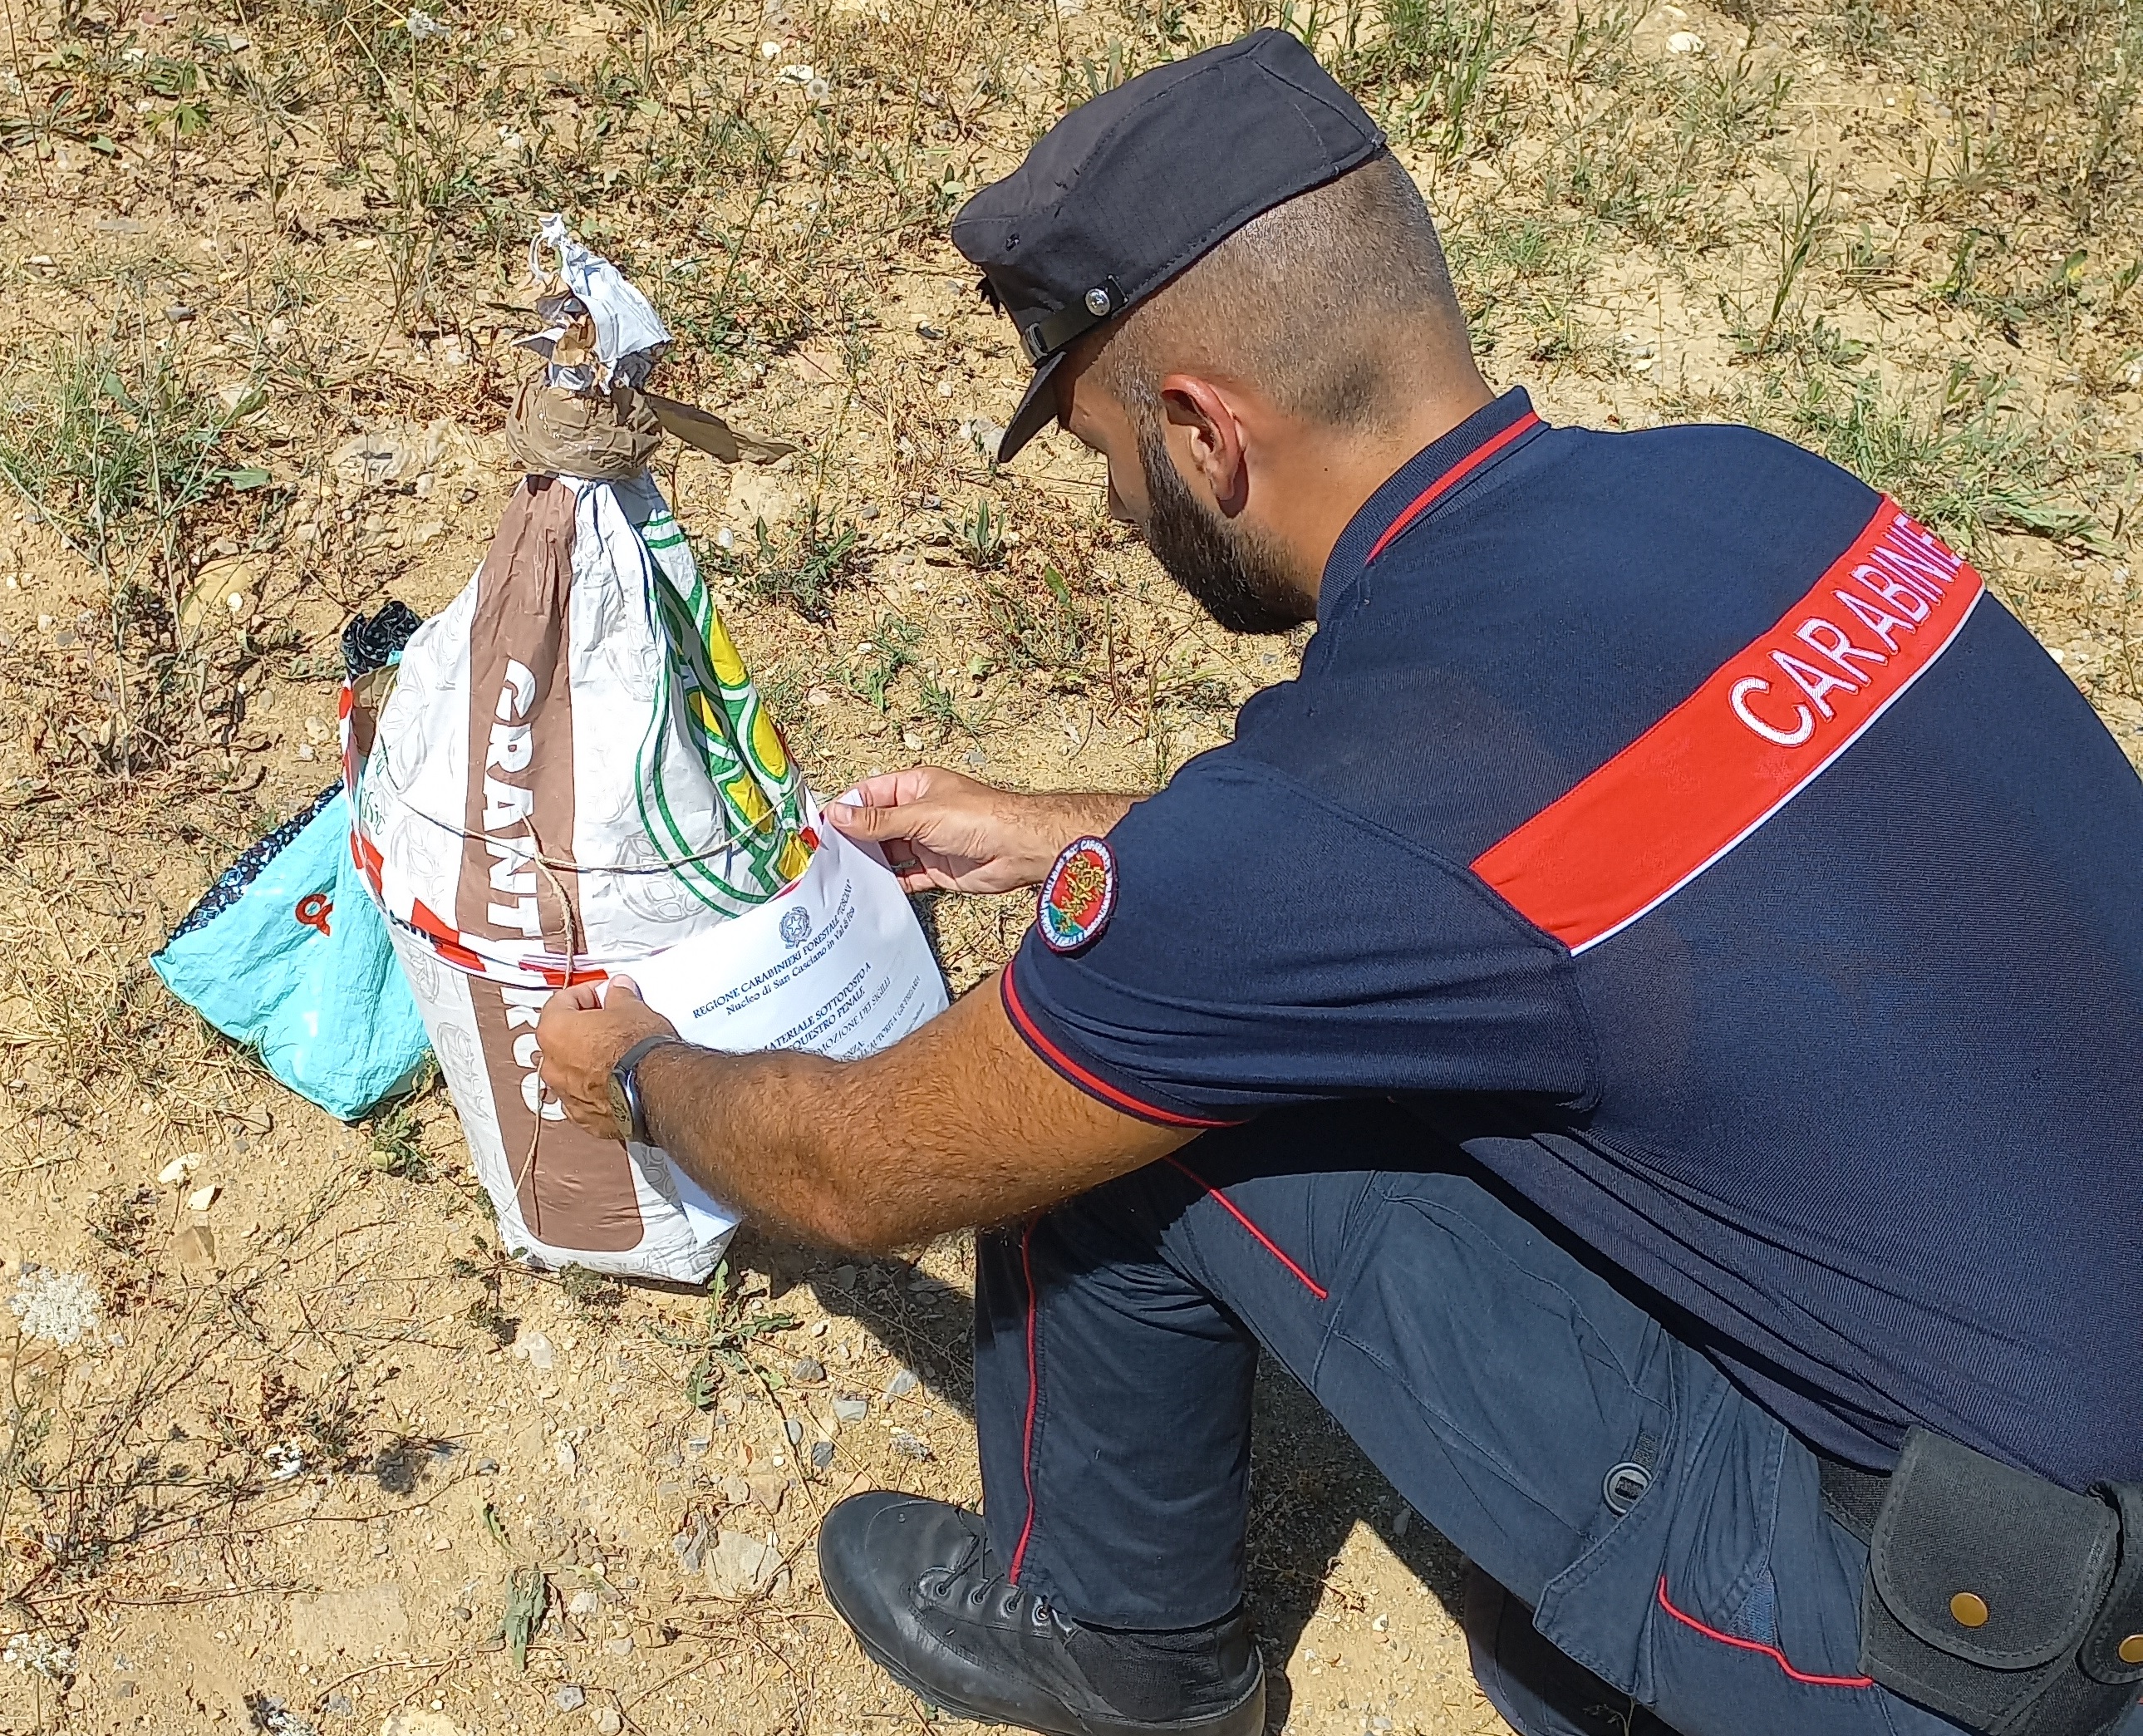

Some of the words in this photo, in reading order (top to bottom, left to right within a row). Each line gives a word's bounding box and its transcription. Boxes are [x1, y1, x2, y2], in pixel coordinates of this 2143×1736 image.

[692, 987, 740, 1019] REGIONE
[740, 950, 802, 993] CARABINIERI
[803, 914, 840, 955] FORESTALE
[725, 992, 760, 1016] Nucleo
[762, 984, 772, 996] di
[773, 974, 791, 989] San
[792, 947, 827, 976] Casciano
[827, 940, 835, 951] in
[815, 967, 866, 1021] SOTTOPOSTO
[865, 961, 872, 973] A
[836, 985, 866, 1019] PENALE
[858, 1001, 872, 1020] DEI
